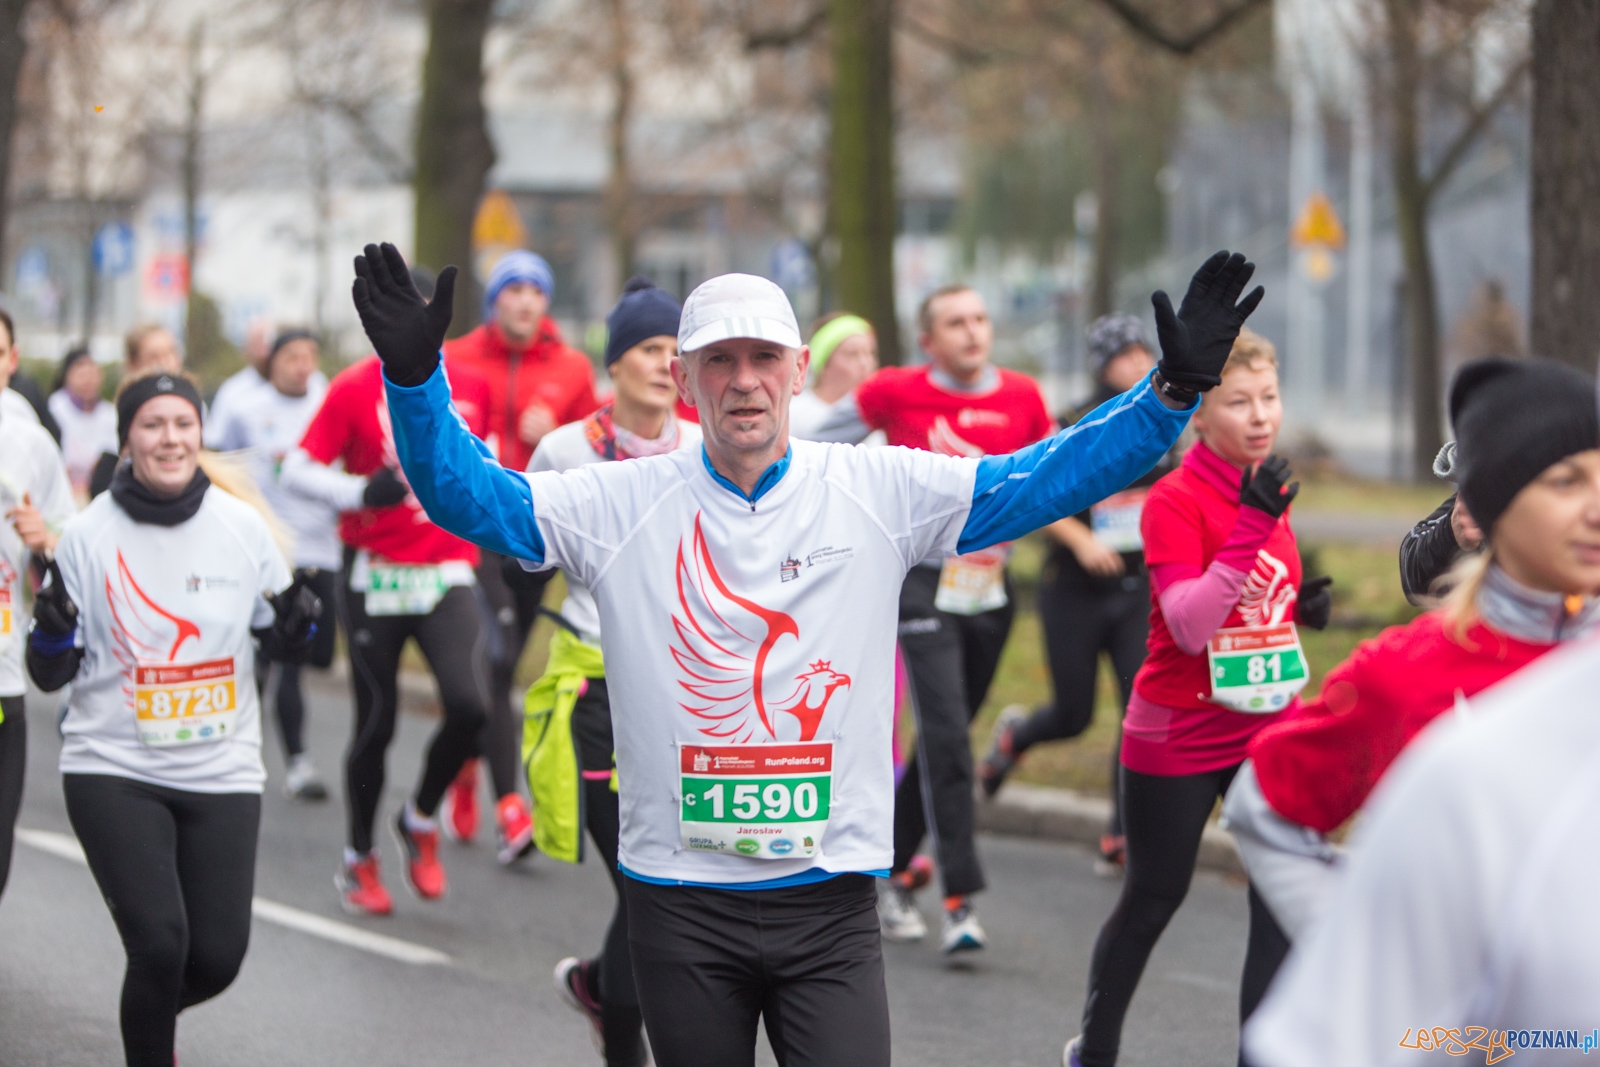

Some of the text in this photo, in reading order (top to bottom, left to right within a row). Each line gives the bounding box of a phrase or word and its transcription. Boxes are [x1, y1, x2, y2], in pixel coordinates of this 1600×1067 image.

[1246, 653, 1282, 685] 81
[150, 684, 229, 719] 8720
[764, 756, 826, 766] RunPoland.org
[703, 782, 819, 820] 1590
